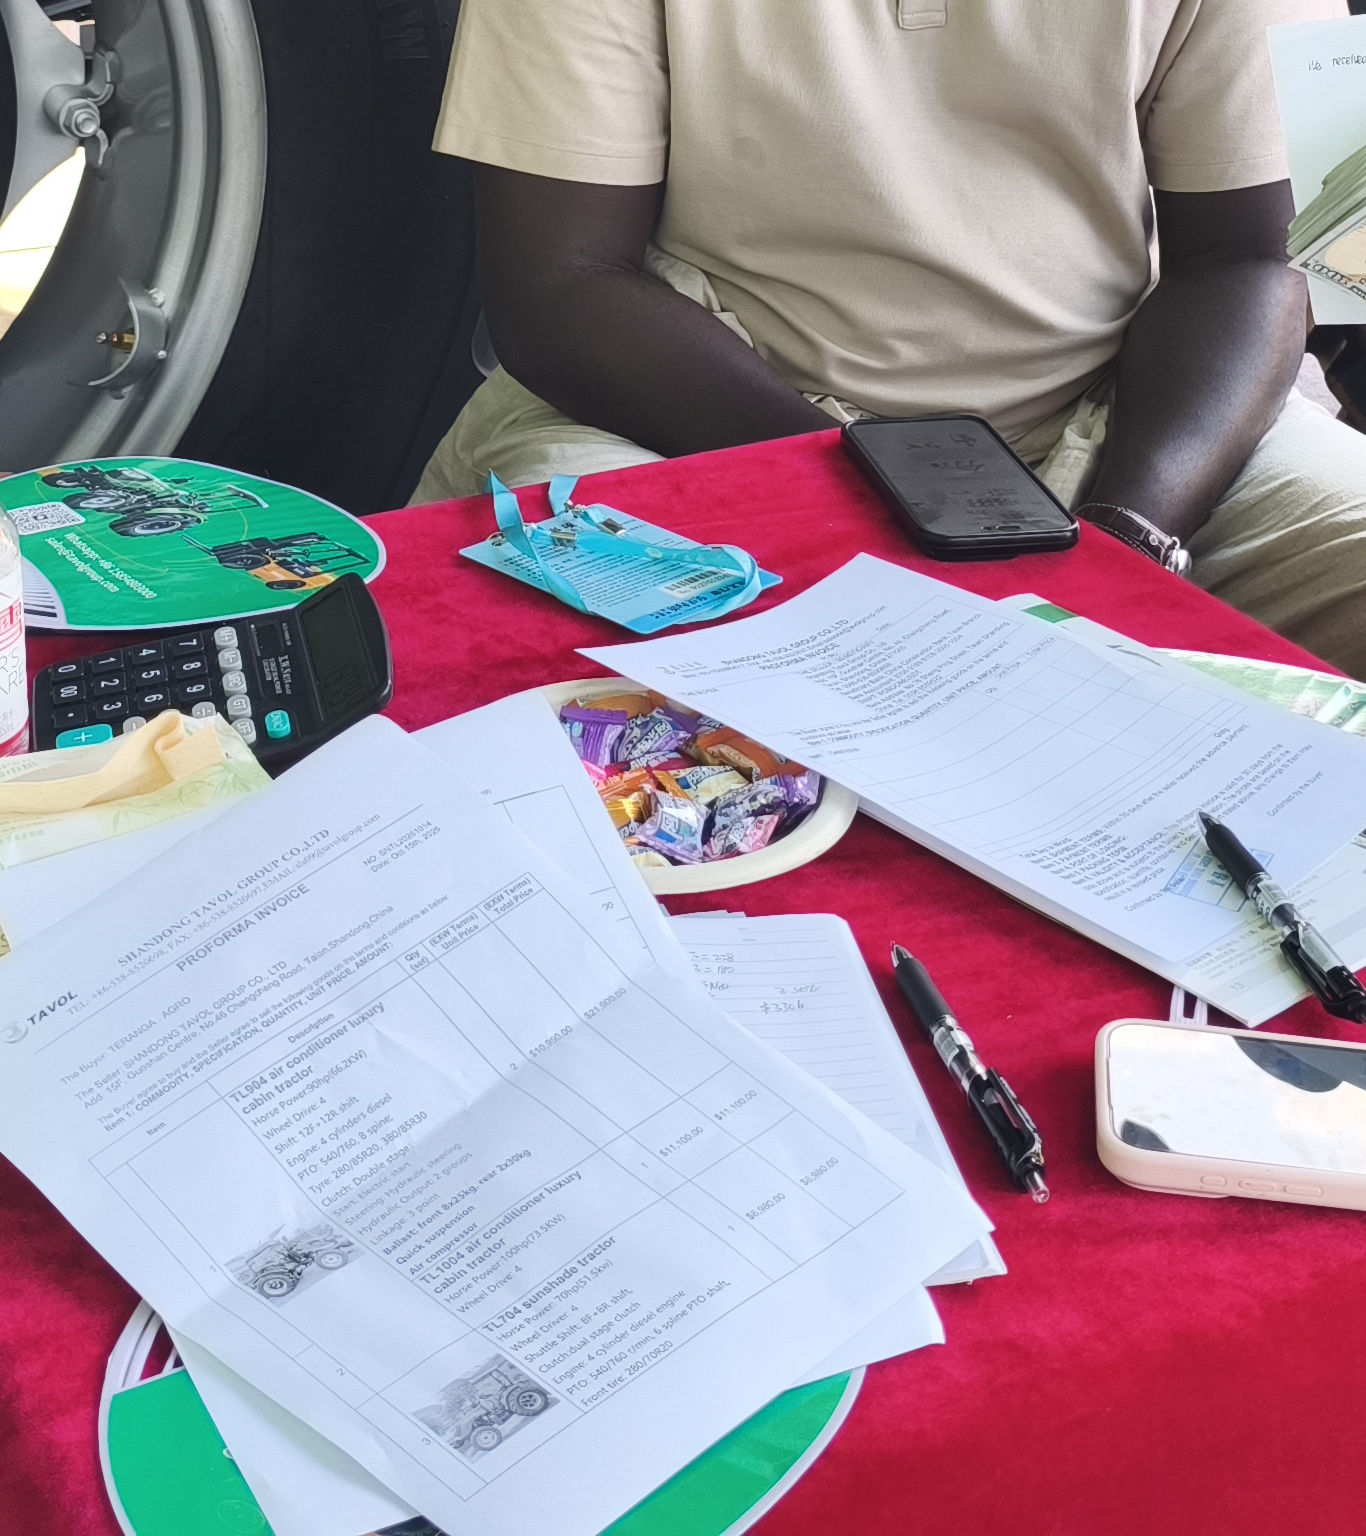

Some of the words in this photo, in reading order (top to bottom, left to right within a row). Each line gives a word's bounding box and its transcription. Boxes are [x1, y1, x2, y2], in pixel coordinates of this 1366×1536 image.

[138, 647, 157, 657] 4
[178, 637, 199, 648] 7
[57, 664, 77, 673] 0
[97, 656, 118, 664] 1
[141, 669, 161, 679] 5
[182, 660, 203, 671] 8
[59, 685, 79, 698] 00
[100, 678, 120, 688] 2
[143, 693, 164, 703] 6
[185, 682, 206, 693] 9
[102, 701, 122, 711] 3
[117, 915, 192, 968] SHANDONG
[190, 889, 238, 918] TAVOL
[236, 859, 280, 890] GROUP
[281, 829, 330, 862] CO.,LTD
[492, 898, 516, 918] Total
[175, 918, 257, 972] PROFORMA
[253, 883, 310, 922] INVOICE
[440, 935, 461, 953] Unit
[457, 924, 482, 942] Price
[404, 949, 424, 966] Qty
[26, 990, 79, 1027] TAVOL
[73, 1084, 96, 1102] The
[94, 1067, 125, 1089] Seller:
[123, 1028, 181, 1069] SHANDONG
[178, 1008, 214, 1032] TAVOL
[212, 984, 247, 1015] GROUP
[266, 960, 287, 976] LTD
[77, 1050, 109, 1074] Buyer:
[107, 1019, 158, 1053] TERANGA
[161, 996, 191, 1020] AGRO
[126, 1051, 169, 1080] Guoshan
[226, 979, 281, 1014] Changcheng
[134, 1067, 195, 1112] COMMODITY,
[191, 1026, 263, 1073] SPECIFICATION,
[260, 996, 308, 1028] QUANTITY,
[304, 981, 327, 1002] UNIT
[325, 967, 357, 988] PRICE,
[354, 941, 394, 970] AMOUNT:
[287, 1013, 335, 1044] Description
[228, 1075, 268, 1103] TL904
[268, 1065, 285, 1081] air
[285, 1024, 349, 1069] conditioner
[347, 1001, 385, 1029] luxury
[241, 1090, 276, 1115] cabin
[274, 1065, 314, 1094] tractor
[713, 1089, 758, 1121] $11,100.00
[250, 1107, 281, 1127] Horse
[262, 1117, 294, 1140] Wheel
[291, 1102, 320, 1123] Drive:
[318, 1095, 327, 1106] 4
[274, 1136, 301, 1155] Shift:
[298, 1109, 340, 1138] 12F+12R
[338, 1095, 360, 1114] shift
[285, 1143, 321, 1168] Engine:
[318, 1135, 328, 1147] 4
[328, 1111, 367, 1141] cylinders
[366, 1092, 393, 1114] diesel
[319, 1137, 361, 1167] 540/760,
[658, 1125, 704, 1157] $11,100.00
[308, 1176, 334, 1194] Tyre:
[321, 1183, 354, 1207] Clutch:
[351, 1162, 387, 1187] Double
[417, 1209, 444, 1230] front
[478, 1169, 498, 1186] rear
[395, 1243, 427, 1265] Quick
[424, 1205, 476, 1245] suspension
[418, 1250, 466, 1284] TL1004
[464, 1238, 483, 1254] air
[482, 1191, 546, 1240] conditioner
[543, 1170, 582, 1195] luxury
[409, 1260, 429, 1276] Air
[425, 1221, 479, 1264] compressor
[481, 1302, 523, 1333] TL704
[519, 1266, 579, 1310] sunshade
[576, 1235, 617, 1267] tractor
[523, 1340, 559, 1364] Shuttle
[556, 1322, 583, 1342] Shift:
[551, 1360, 589, 1385] Engine:
[595, 1329, 630, 1356] cylinder
[629, 1310, 657, 1332] diesel
[655, 1290, 686, 1314] engine
[565, 1378, 591, 1396] PTO:
[589, 1351, 628, 1381] 540/760
[661, 1309, 689, 1330] spline
[685, 1294, 707, 1311] PTO
[580, 1386, 610, 1408] Front
